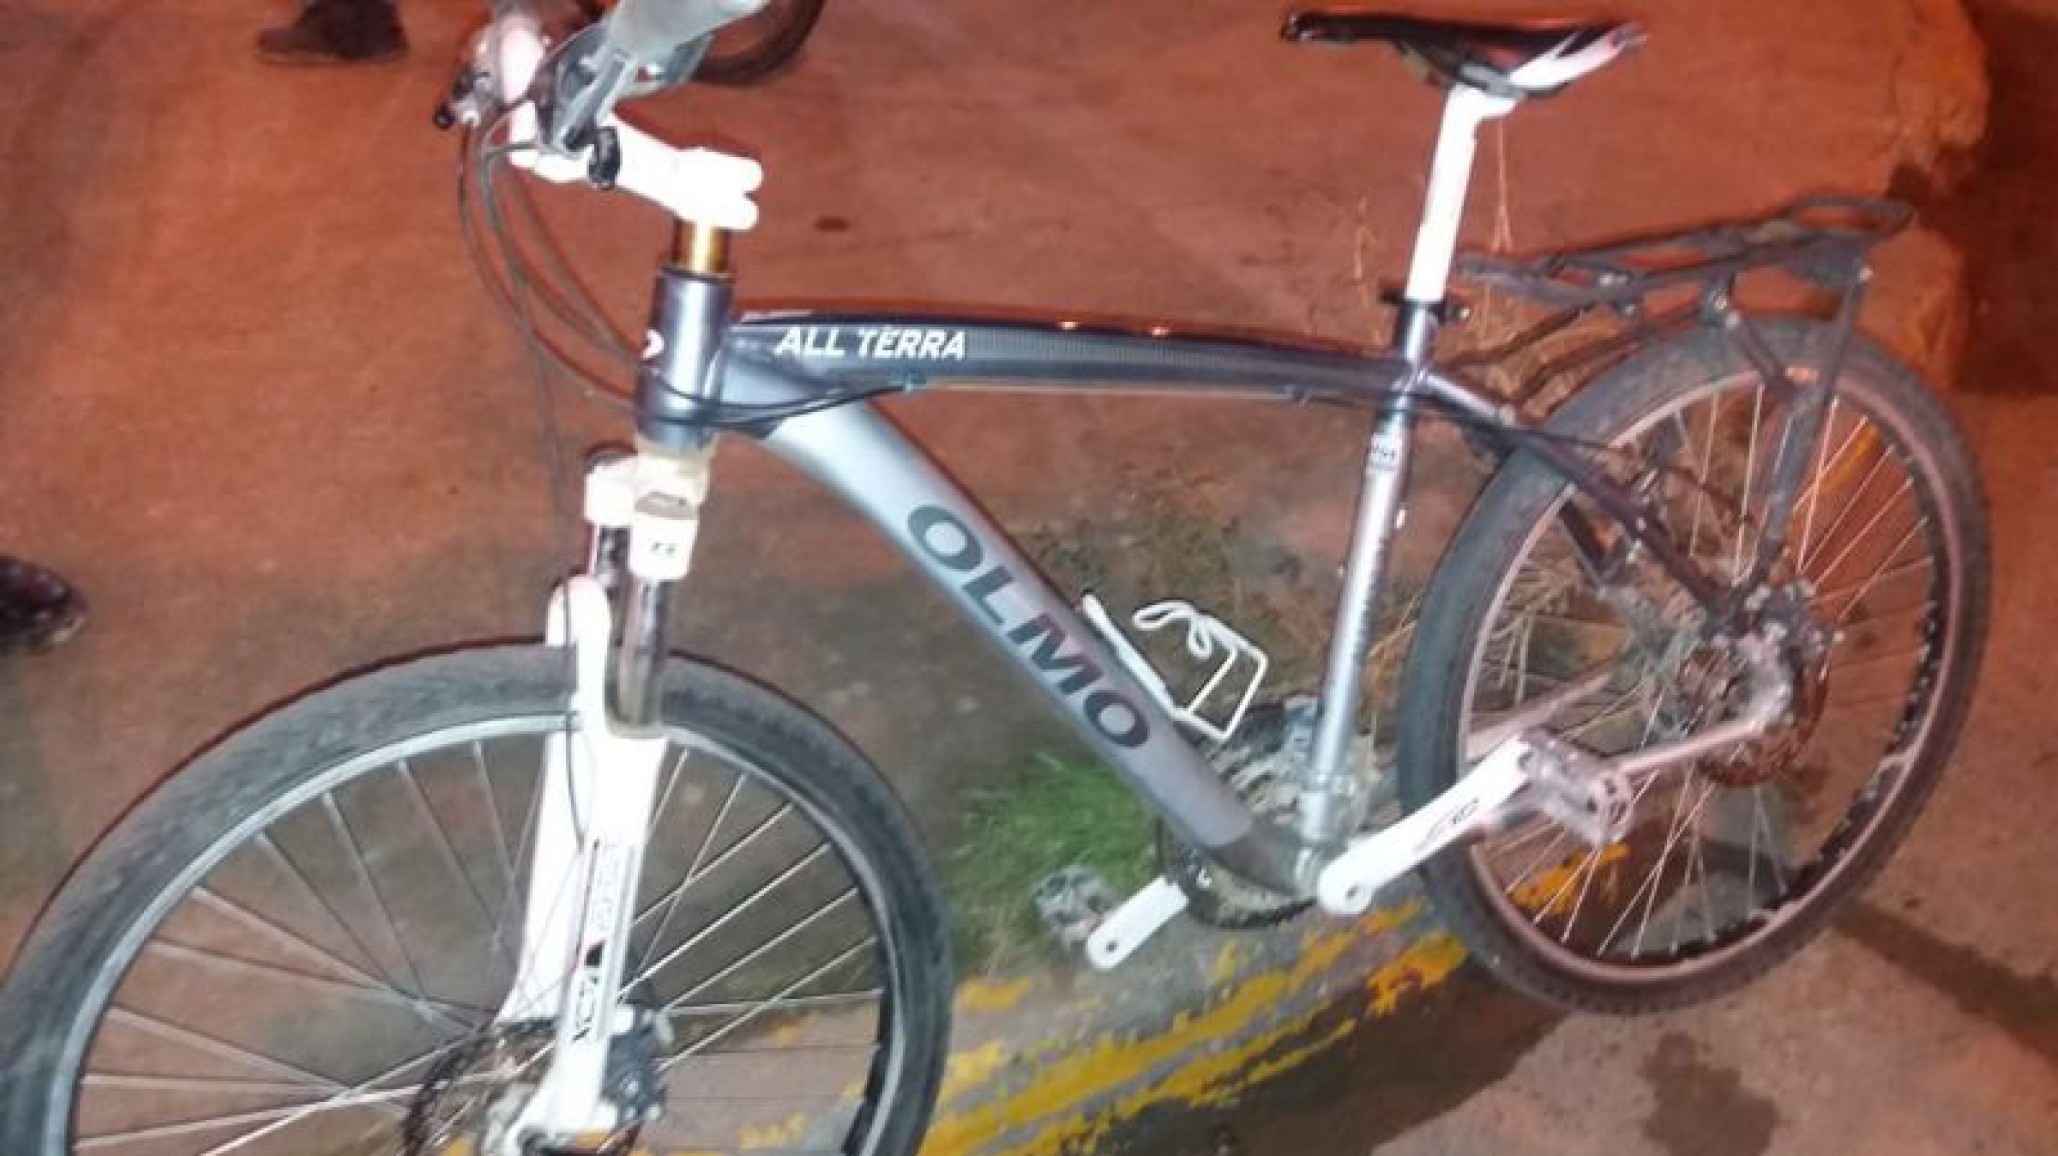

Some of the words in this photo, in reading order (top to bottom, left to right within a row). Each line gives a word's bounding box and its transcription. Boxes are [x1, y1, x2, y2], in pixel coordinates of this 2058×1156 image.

[774, 325, 845, 356] ALL
[857, 328, 966, 361] TERRA
[907, 504, 1149, 749] OLMO
